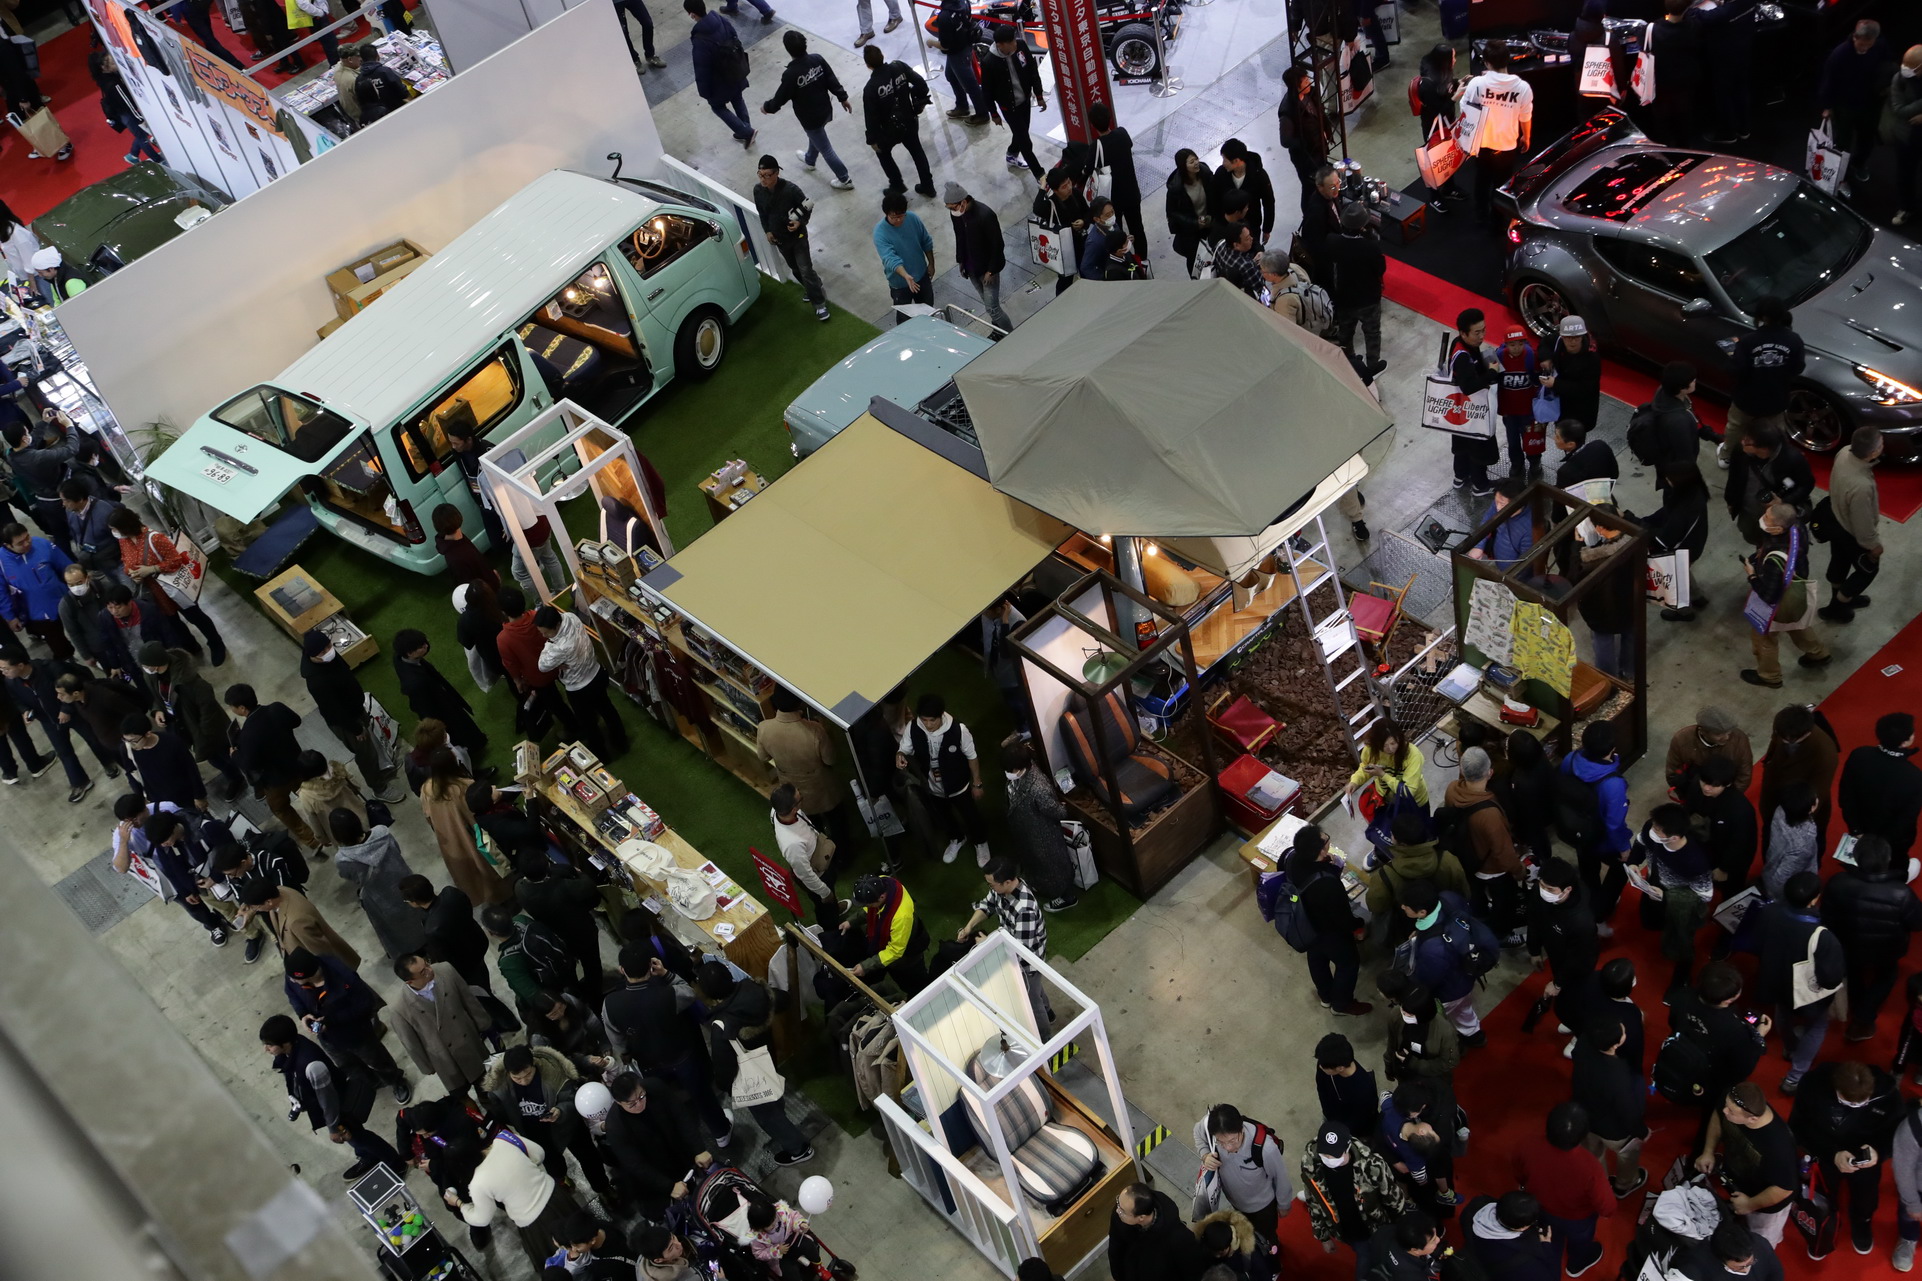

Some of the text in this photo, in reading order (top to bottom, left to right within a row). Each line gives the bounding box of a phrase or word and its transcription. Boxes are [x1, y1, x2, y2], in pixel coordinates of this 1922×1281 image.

[1587, 69, 1607, 77] LIGHT
[1437, 160, 1453, 174] LIGHT
[1427, 404, 1449, 416] LIGHT
[1463, 400, 1490, 414] Liberty
[1466, 411, 1487, 421] Walk
